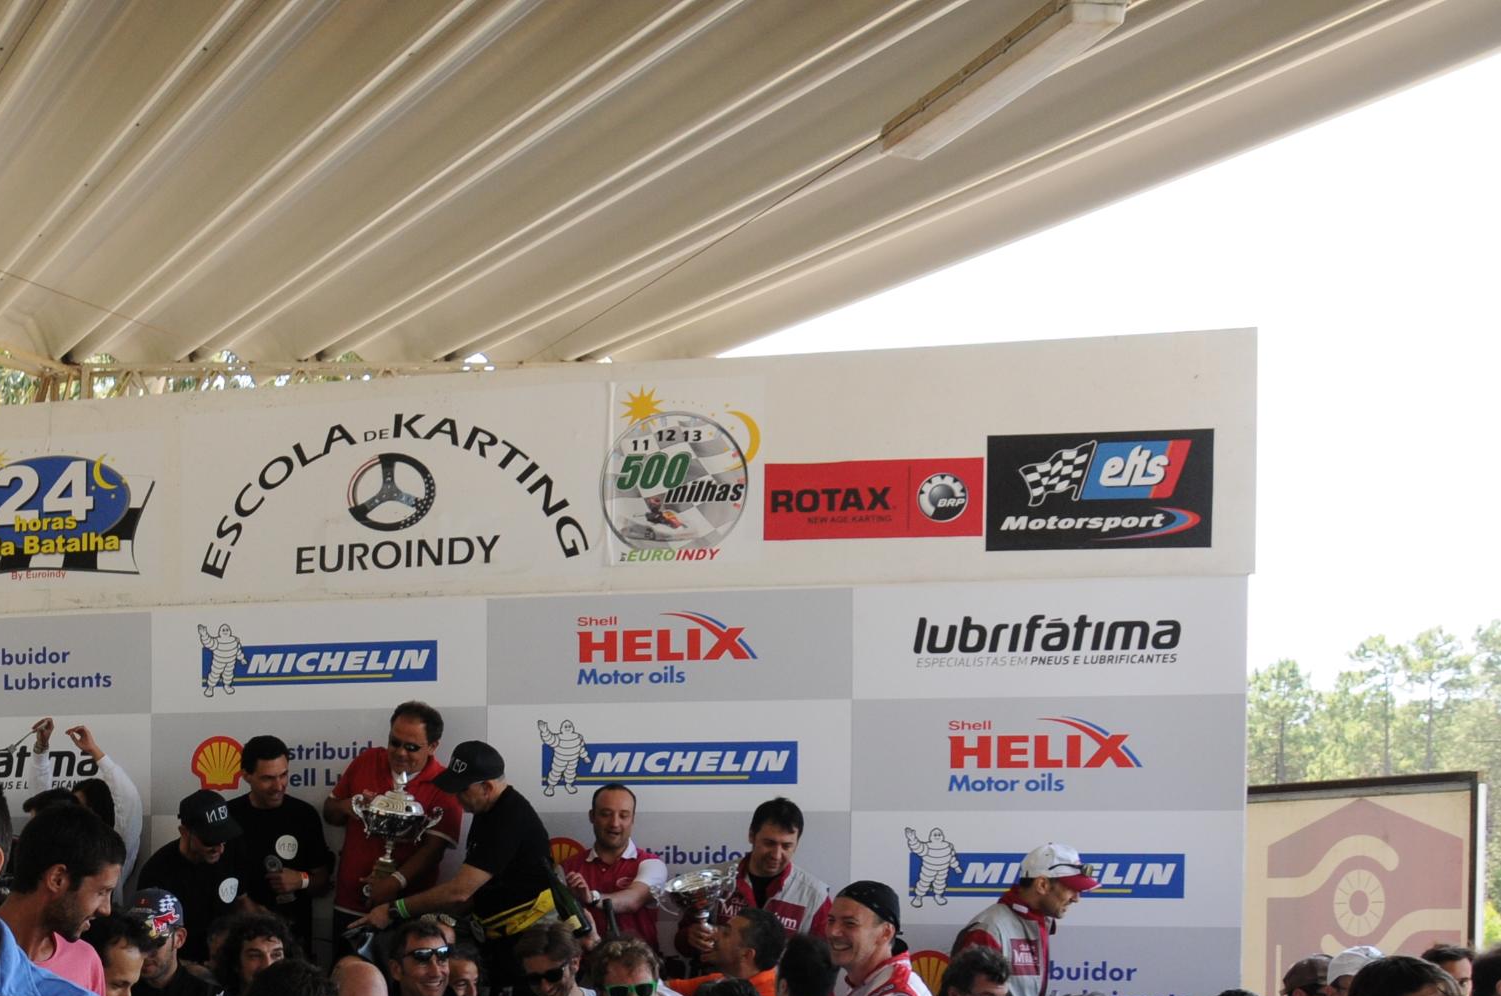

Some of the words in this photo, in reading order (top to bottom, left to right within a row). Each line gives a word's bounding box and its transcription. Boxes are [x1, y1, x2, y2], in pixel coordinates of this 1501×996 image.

[632, 440, 649, 451] 11
[657, 430, 676, 441] 12
[683, 430, 702, 442] 13
[617, 451, 693, 490] 500
[202, 424, 356, 579] ESCOLA
[364, 429, 390, 442] DE
[393, 413, 589, 558] KARTING
[665, 480, 745, 503] milhas
[771, 486, 891, 513] ROTAX
[937, 498, 966, 508] BRP
[15, 515, 78, 532] horas
[808, 517, 828, 525] NEW
[852, 515, 892, 523] KARTING
[1000, 513, 1165, 532] Motorsport
[23, 532, 120, 555] Batalha
[296, 535, 500, 575] EUROINDY
[627, 549, 720, 562] EUROINDY
[11, 571, 22, 581] By
[26, 570, 67, 580] Euroindy
[577, 616, 617, 627] Shell
[577, 626, 750, 663] HELIX
[247, 648, 430, 674] MICHELIN
[916, 655, 1007, 668] ESPECIALISTAS
[1010, 656, 1028, 666] EM
[1030, 655, 1070, 666] PNEUS
[1073, 655, 1080, 664] E
[1083, 653, 1178, 665] LUBRIFICANTES
[4, 671, 112, 690] Lubricants
[577, 667, 643, 685] Motor
[648, 665, 686, 684] oils
[948, 720, 992, 731] Shell
[948, 733, 1135, 769] HELIX
[591, 750, 790, 773] MICHELIN
[289, 767, 316, 787] ell
[948, 774, 1020, 792] Motor
[1025, 773, 1065, 792] oils
[962, 862, 1176, 886] MIELIN
[1050, 960, 1137, 981] buidor
